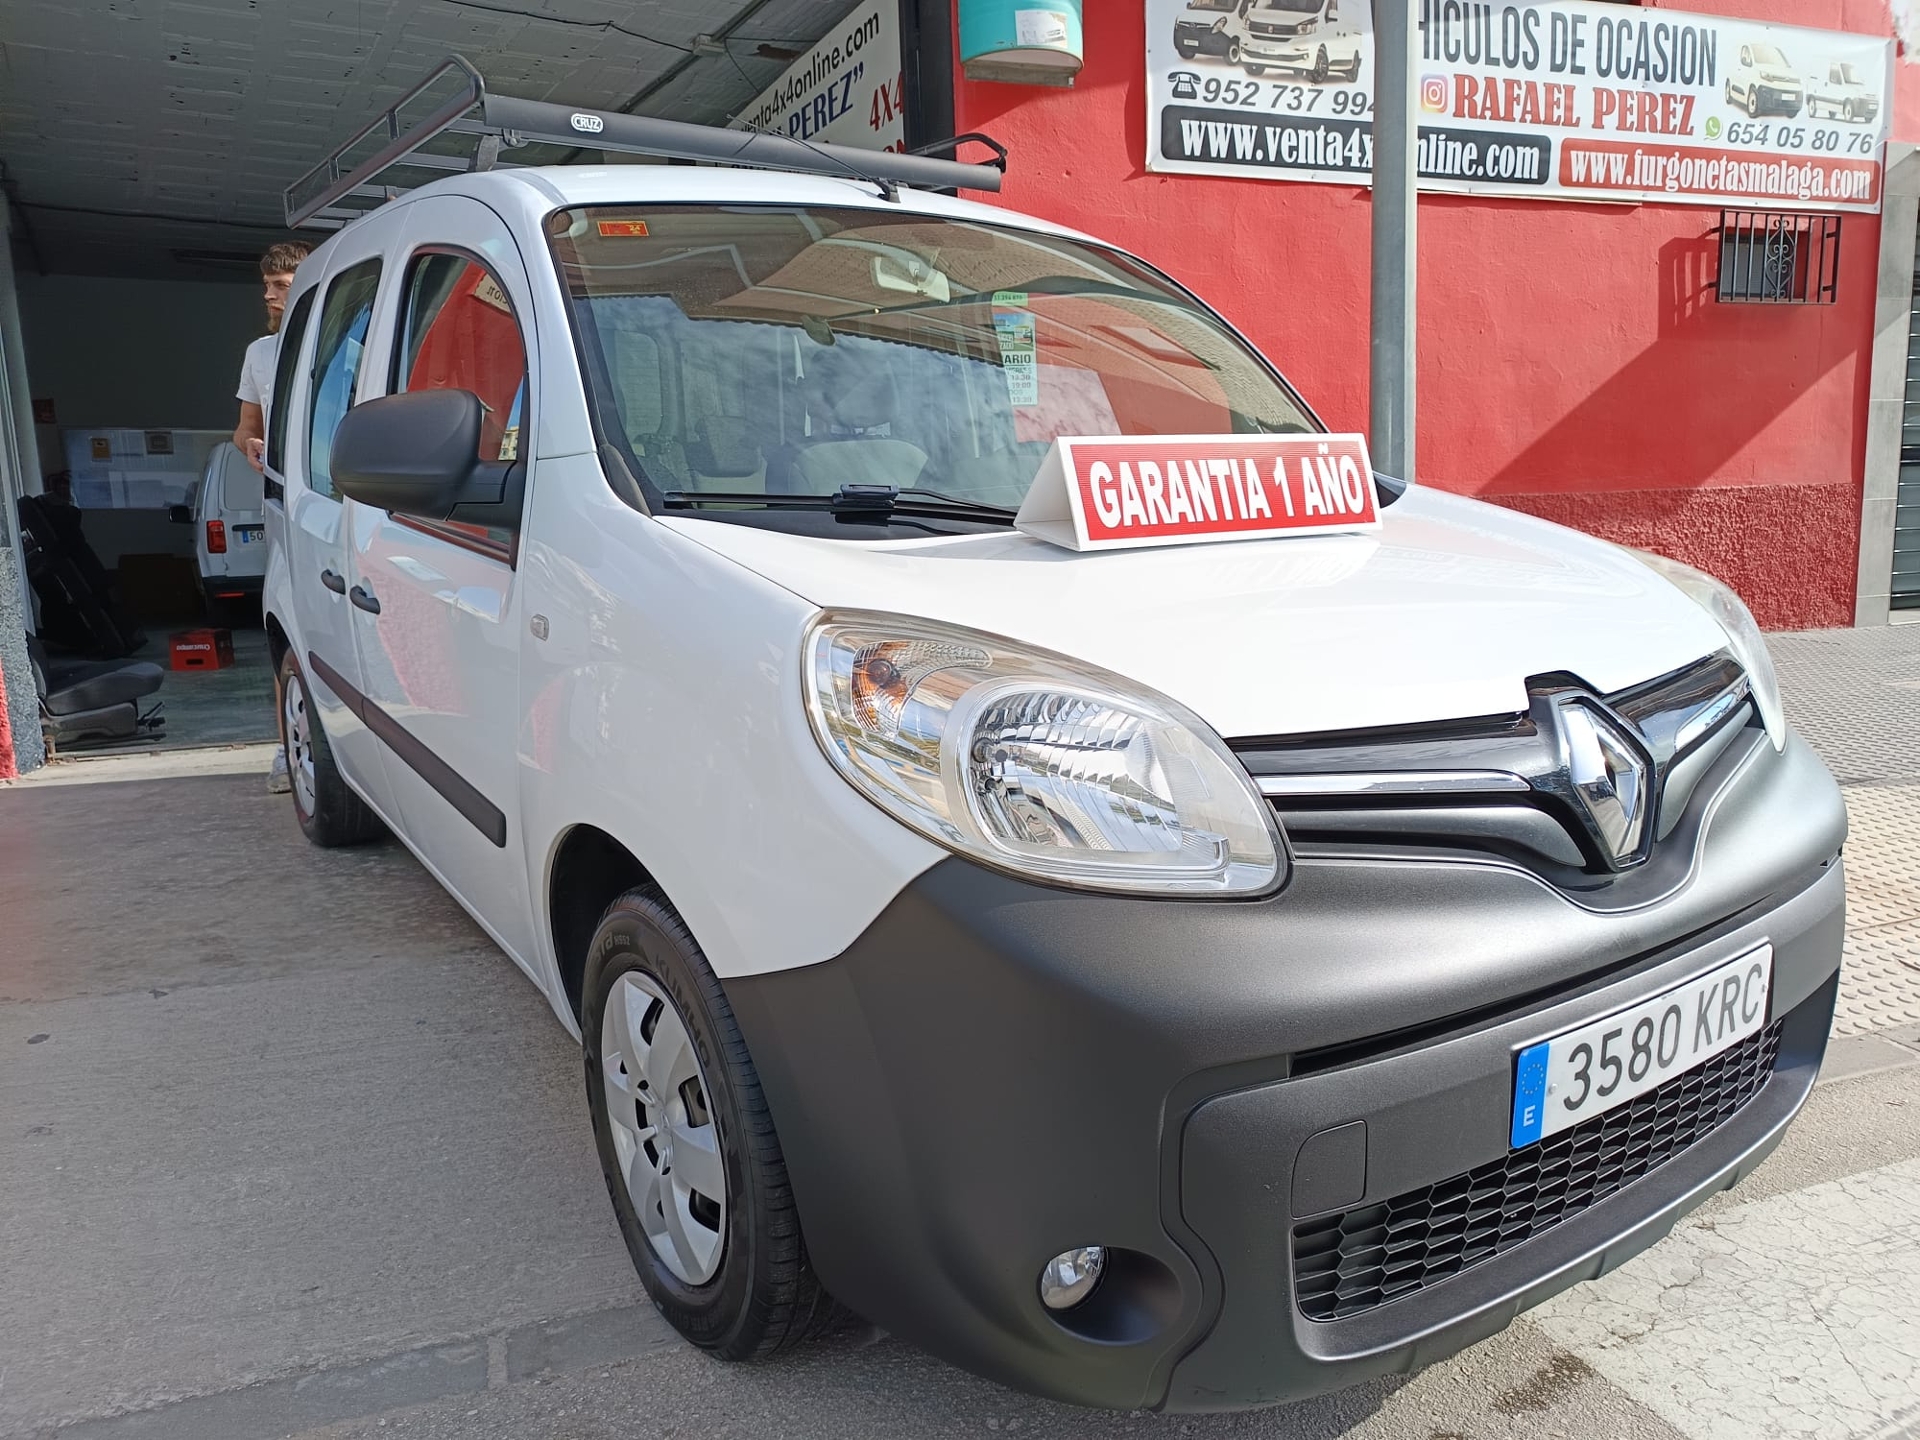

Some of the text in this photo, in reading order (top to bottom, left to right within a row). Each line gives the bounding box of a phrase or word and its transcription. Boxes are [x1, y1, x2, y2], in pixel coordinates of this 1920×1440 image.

[1550, 12, 1587, 76] DE
[1596, 17, 1716, 87] OCASION
[1202, 77, 1260, 107] 952
[1270, 84, 1323, 113] 737
[1453, 74, 1696, 136] RAFAEL PEREZ
[573, 116, 601, 131] CRUZ
[1180, 119, 1539, 181] www.venta4xnline.com
[1727, 122, 1873, 154] 654 05 80 76
[1570, 149, 1872, 200] www.furgonetasmalaga.com
[1089, 442, 1364, 529] GARANTIA 1 AÑO
[1563, 963, 1763, 1111] 3580 KRC
[1522, 1105, 1536, 1127] E
